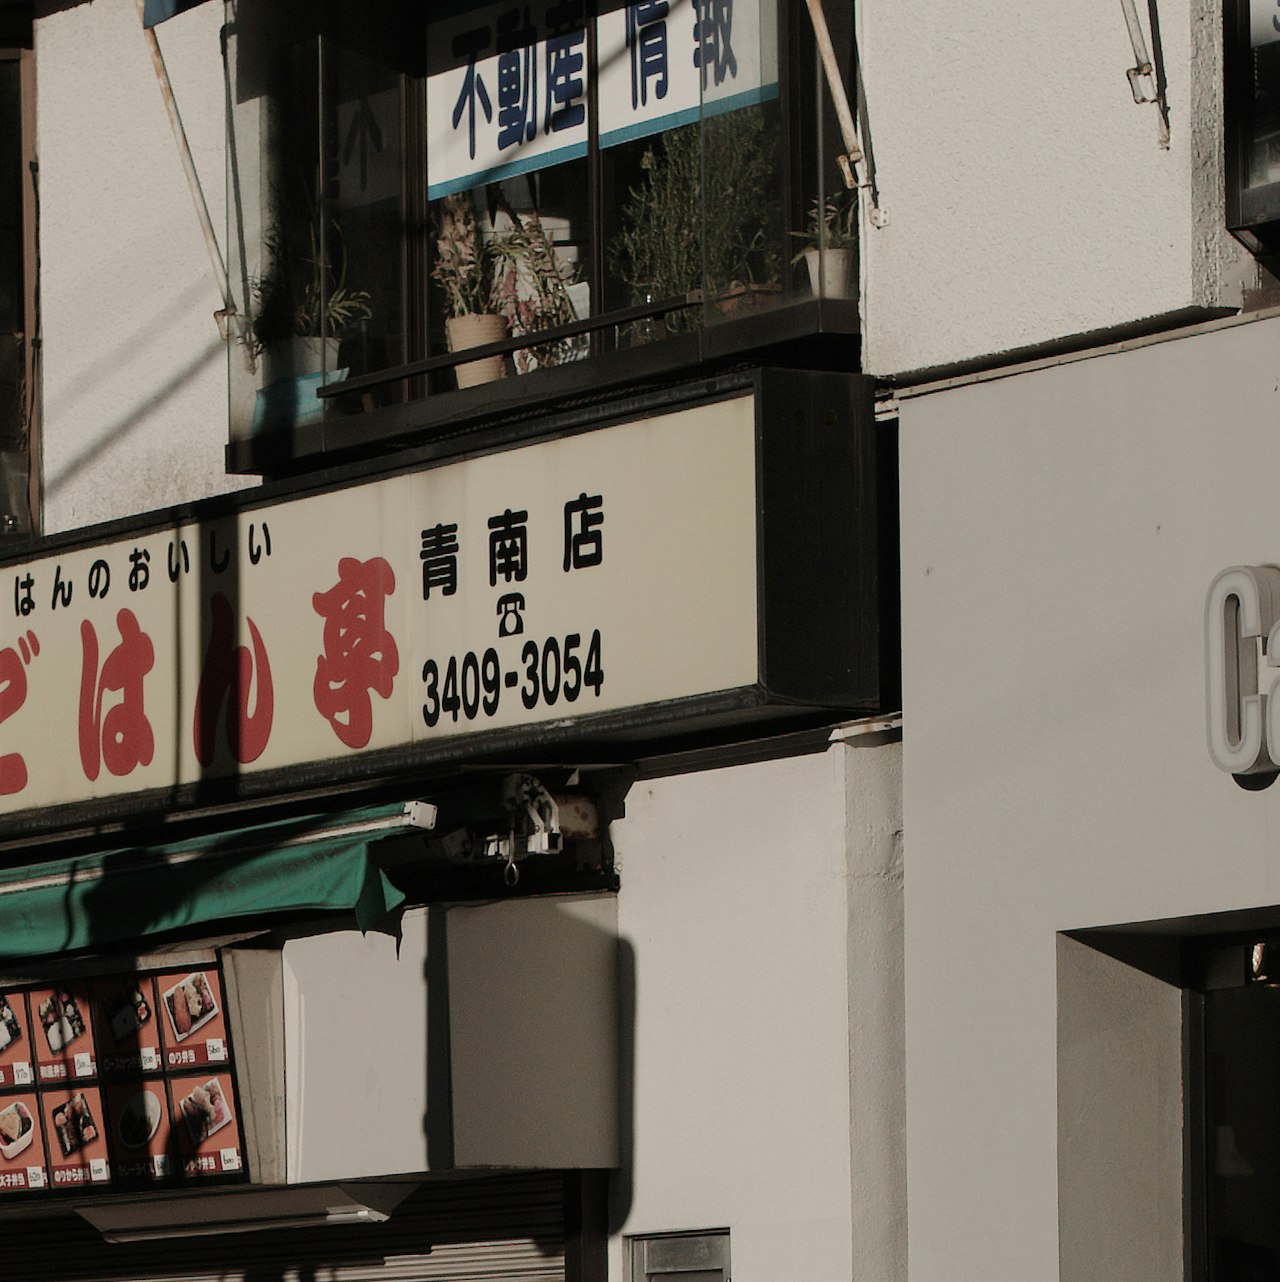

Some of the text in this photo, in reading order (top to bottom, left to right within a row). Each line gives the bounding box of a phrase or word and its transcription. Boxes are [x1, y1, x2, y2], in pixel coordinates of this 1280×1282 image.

[421, 493, 604, 600] 青南店
[422, 629, 604, 727] 3409-3054
